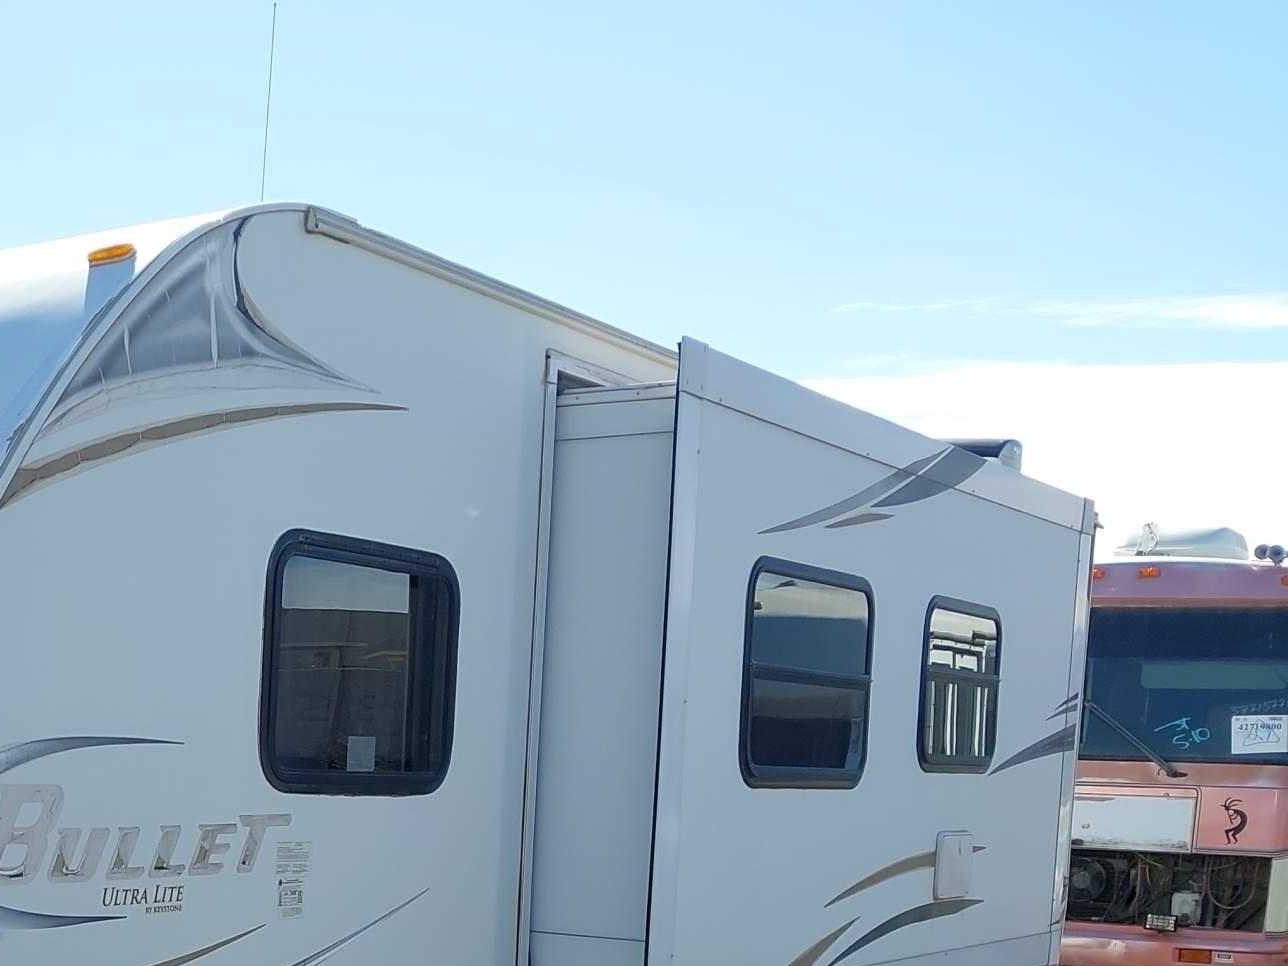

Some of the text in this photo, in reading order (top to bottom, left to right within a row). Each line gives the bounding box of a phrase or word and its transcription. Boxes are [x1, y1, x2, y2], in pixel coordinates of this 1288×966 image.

[102, 884, 185, 907] ULTRA LITE
[145, 904, 183, 915] BY KEYSTONE
